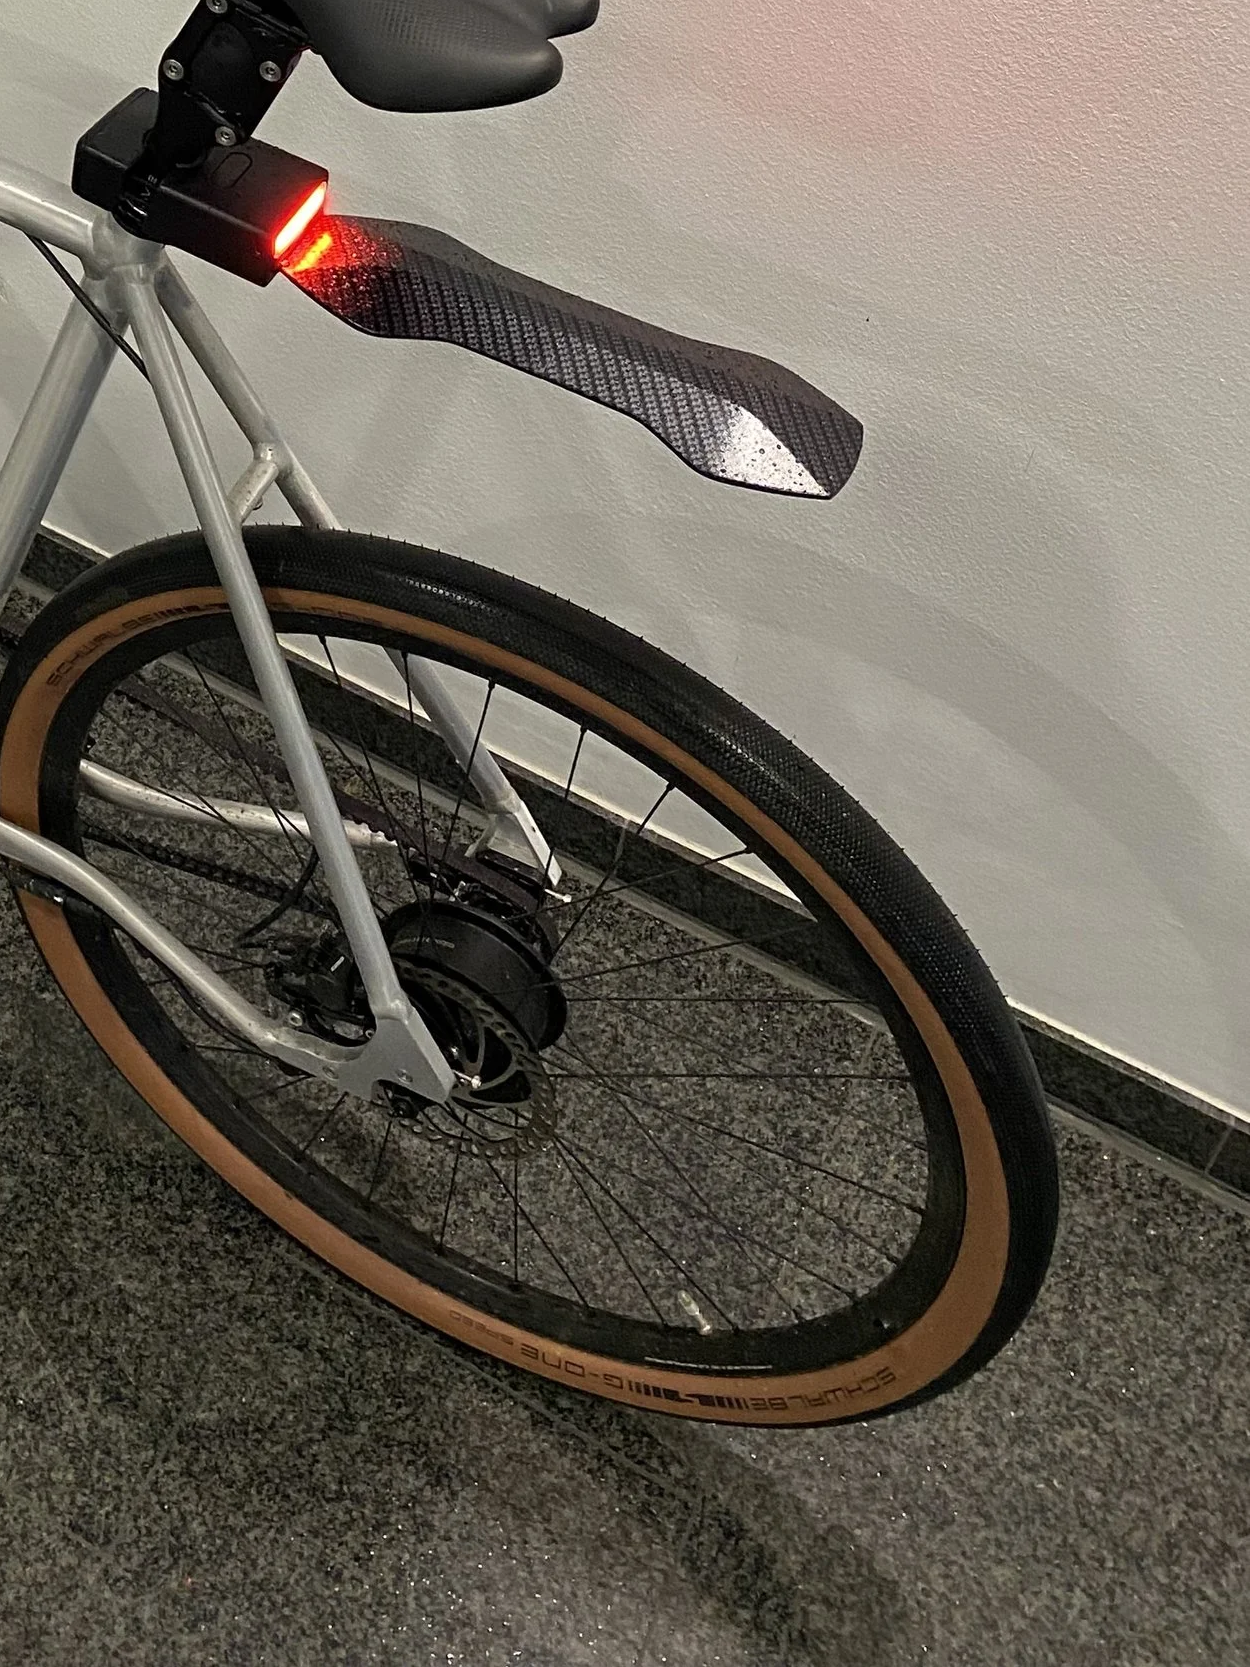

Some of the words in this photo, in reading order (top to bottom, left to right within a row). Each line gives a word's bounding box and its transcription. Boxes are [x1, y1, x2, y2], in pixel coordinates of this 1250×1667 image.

[46, 613, 154, 686] SCHWALBE
[449, 1310, 514, 1346] SPEED
[520, 1343, 624, 1389] G-ONE
[751, 1366, 897, 1411] SCHWALBE
